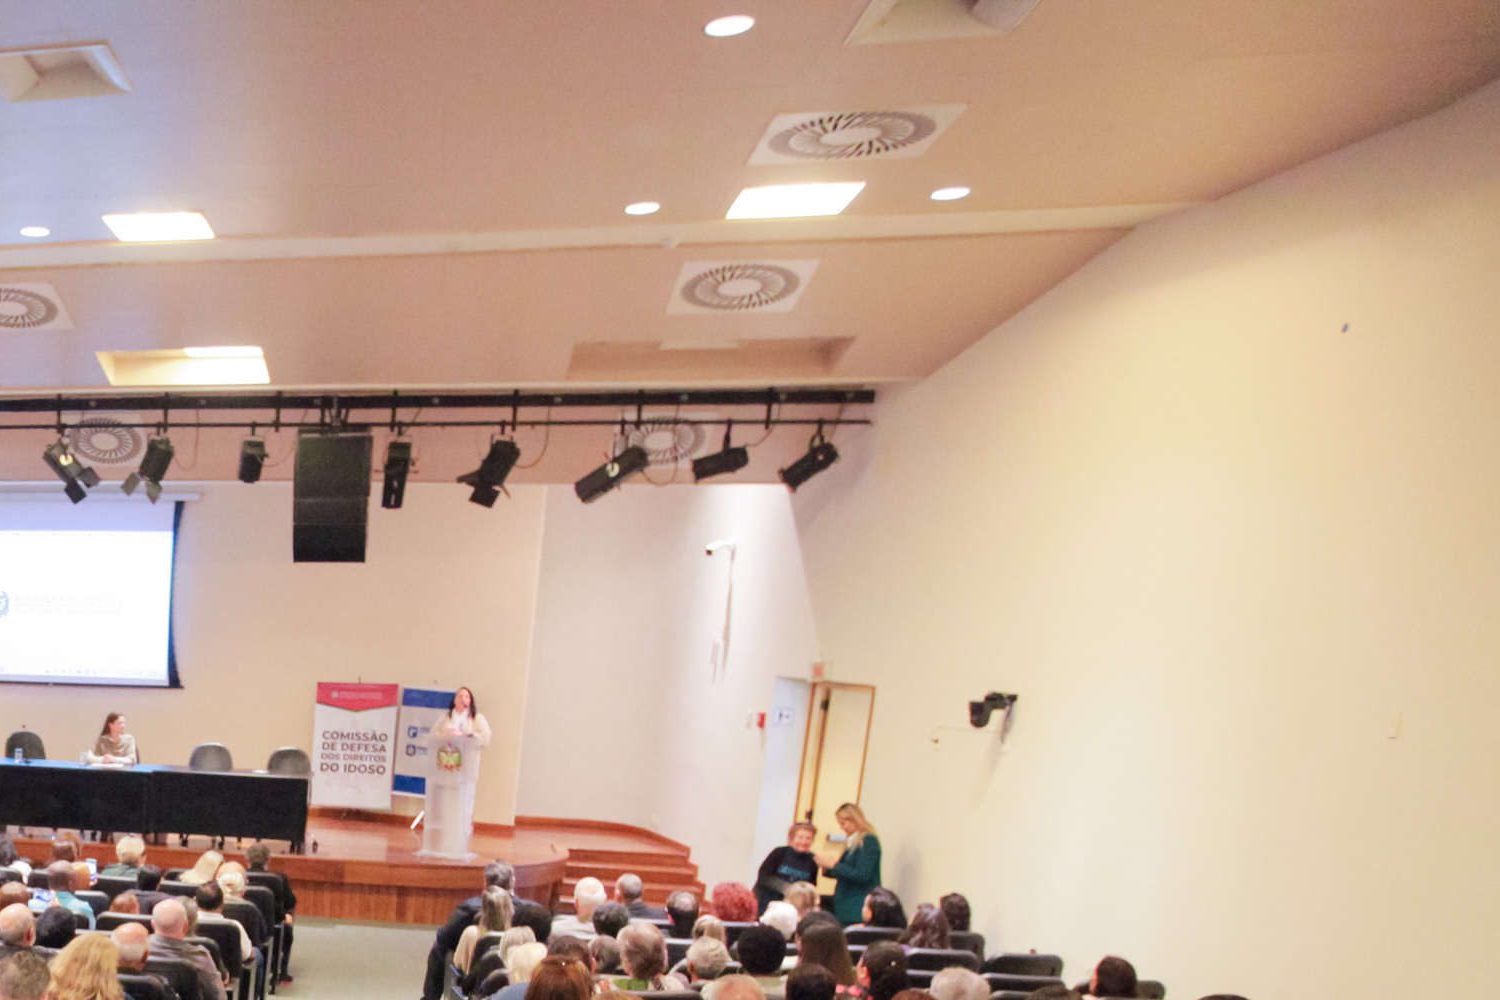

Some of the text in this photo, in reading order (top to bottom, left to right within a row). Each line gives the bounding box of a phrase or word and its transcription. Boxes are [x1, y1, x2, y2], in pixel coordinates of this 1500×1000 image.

[322, 730, 388, 742] COMISSÃO
[322, 742, 387, 753] DE DEFESA
[321, 752, 387, 763] DOS DIREITOS
[320, 762, 386, 775] DO IDOSO
